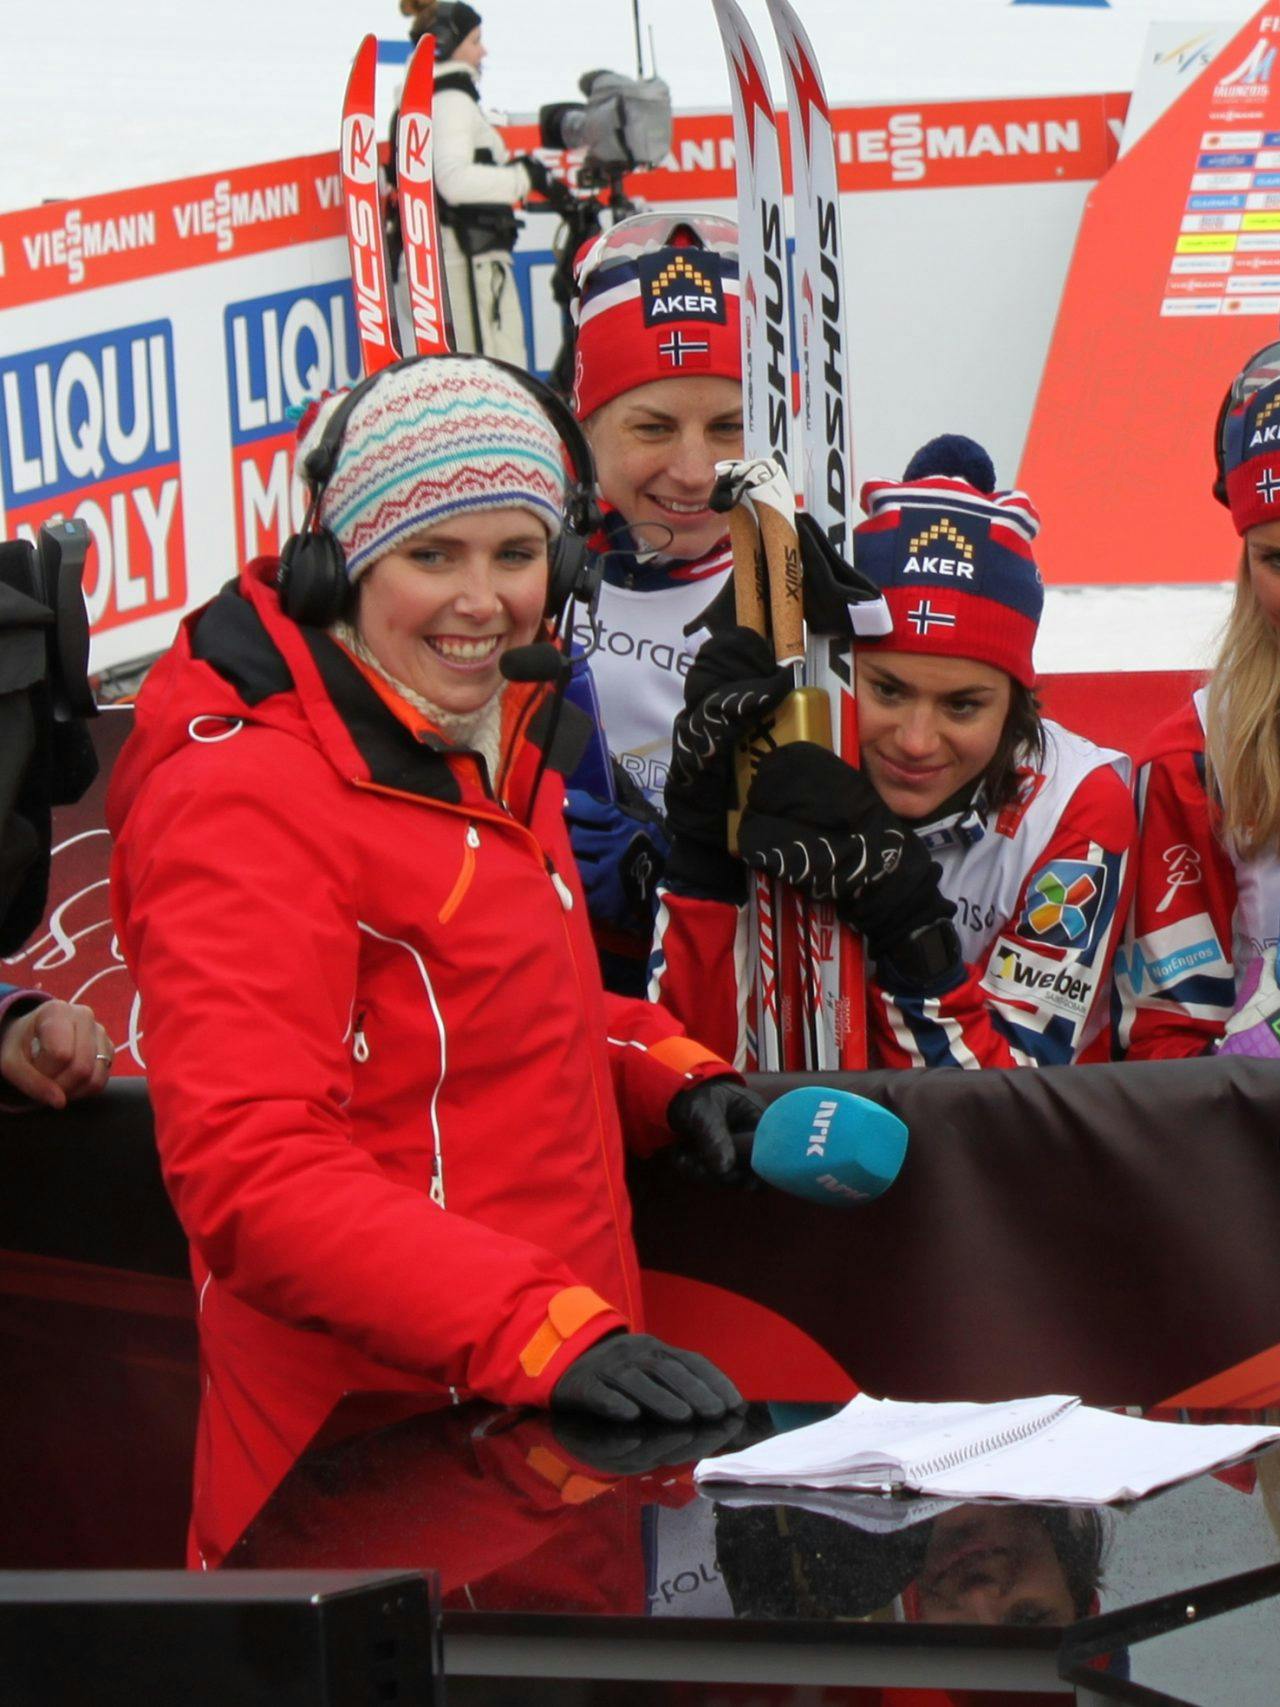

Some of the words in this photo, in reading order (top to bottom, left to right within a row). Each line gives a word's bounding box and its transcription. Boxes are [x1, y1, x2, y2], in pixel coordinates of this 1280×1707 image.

[833, 113, 1081, 181] IESSMANN
[23, 210, 155, 284] VIESSMANN
[172, 180, 300, 252] VIESSMANN
[349, 194, 385, 346] WCS
[404, 193, 439, 345] WCS
[652, 296, 717, 316] AKER
[233, 295, 364, 432] LIQU
[3, 334, 172, 494] LIQUI
[903, 556, 975, 580] AKER
[1013, 961, 1092, 1003] weber
